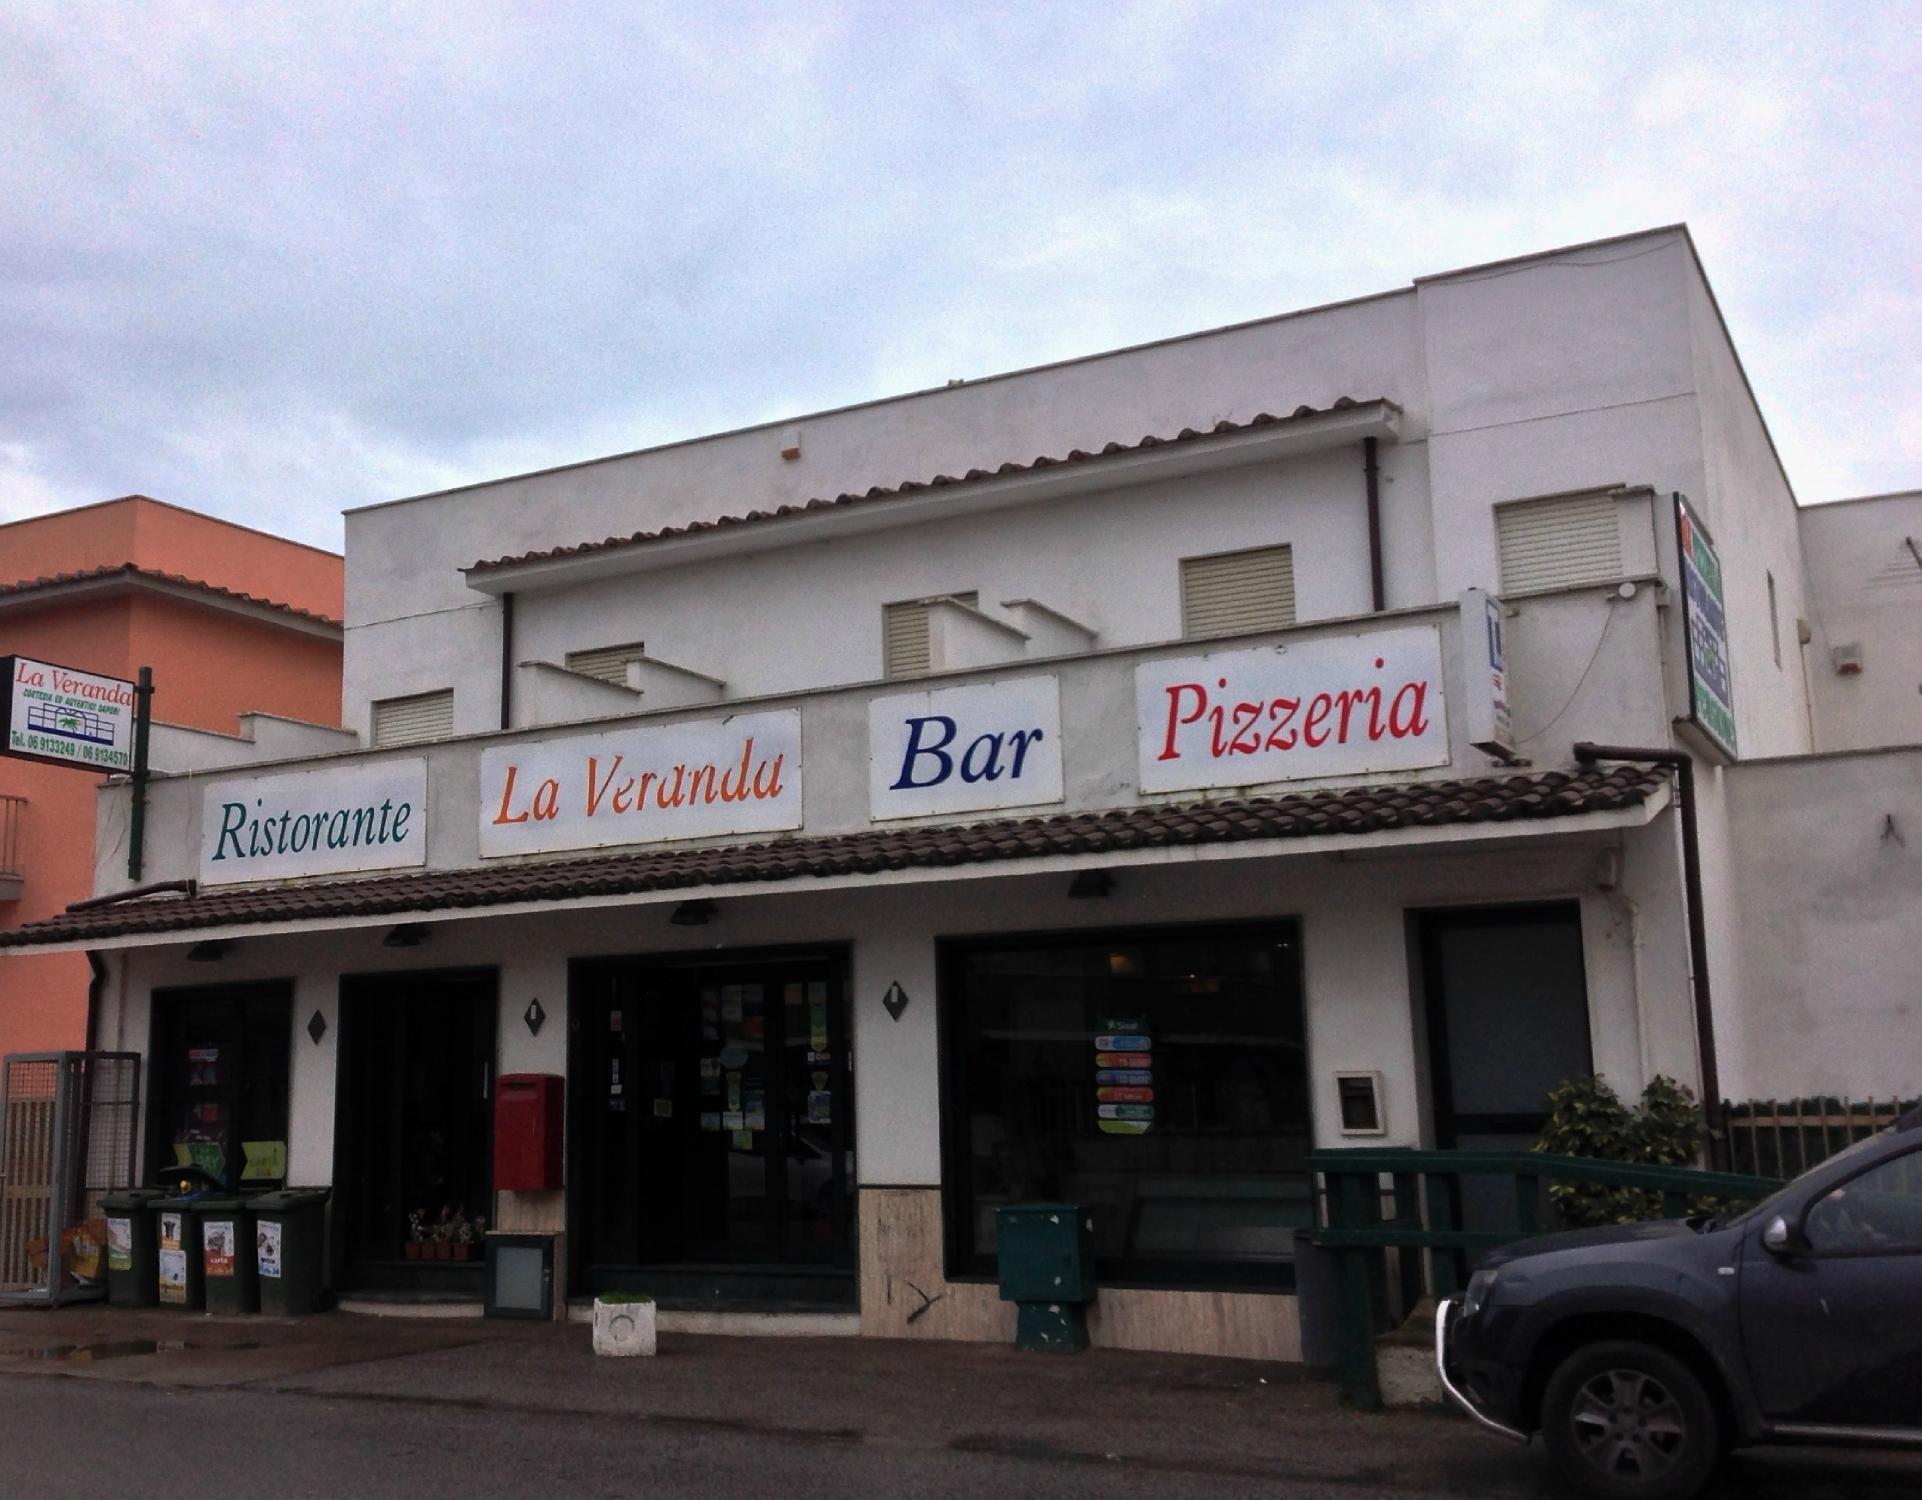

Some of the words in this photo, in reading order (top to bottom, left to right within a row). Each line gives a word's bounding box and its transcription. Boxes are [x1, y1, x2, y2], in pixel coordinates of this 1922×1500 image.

[16, 662, 43, 687] La
[52, 669, 131, 706] Veranda
[1158, 658, 1429, 761] Pizzeria
[28, 734, 38, 749] 06
[83, 745, 93, 760] 06
[493, 766, 559, 825] La
[586, 737, 784, 817] Veranda
[889, 716, 1043, 791] Bar
[212, 797, 411, 861] Ristorante
